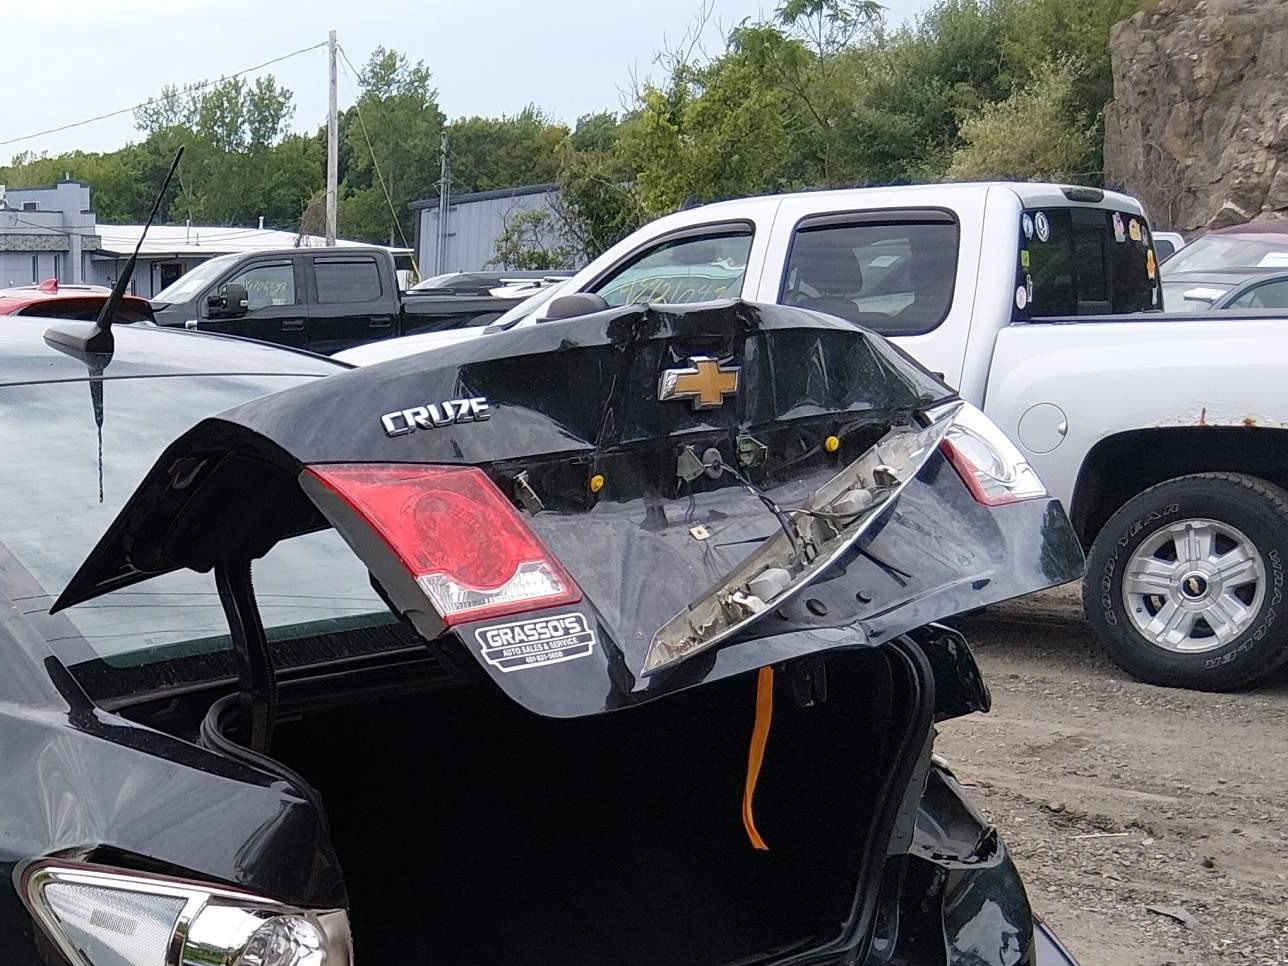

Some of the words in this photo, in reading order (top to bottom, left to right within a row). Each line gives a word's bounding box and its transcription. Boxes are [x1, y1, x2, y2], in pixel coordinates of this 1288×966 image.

[381, 397, 491, 437] CRUZE
[486, 617, 581, 648] GRASSO'S
[503, 647, 521, 657] AUTO
[522, 643, 544, 654] SALES
[551, 637, 579, 649] SERVICE
